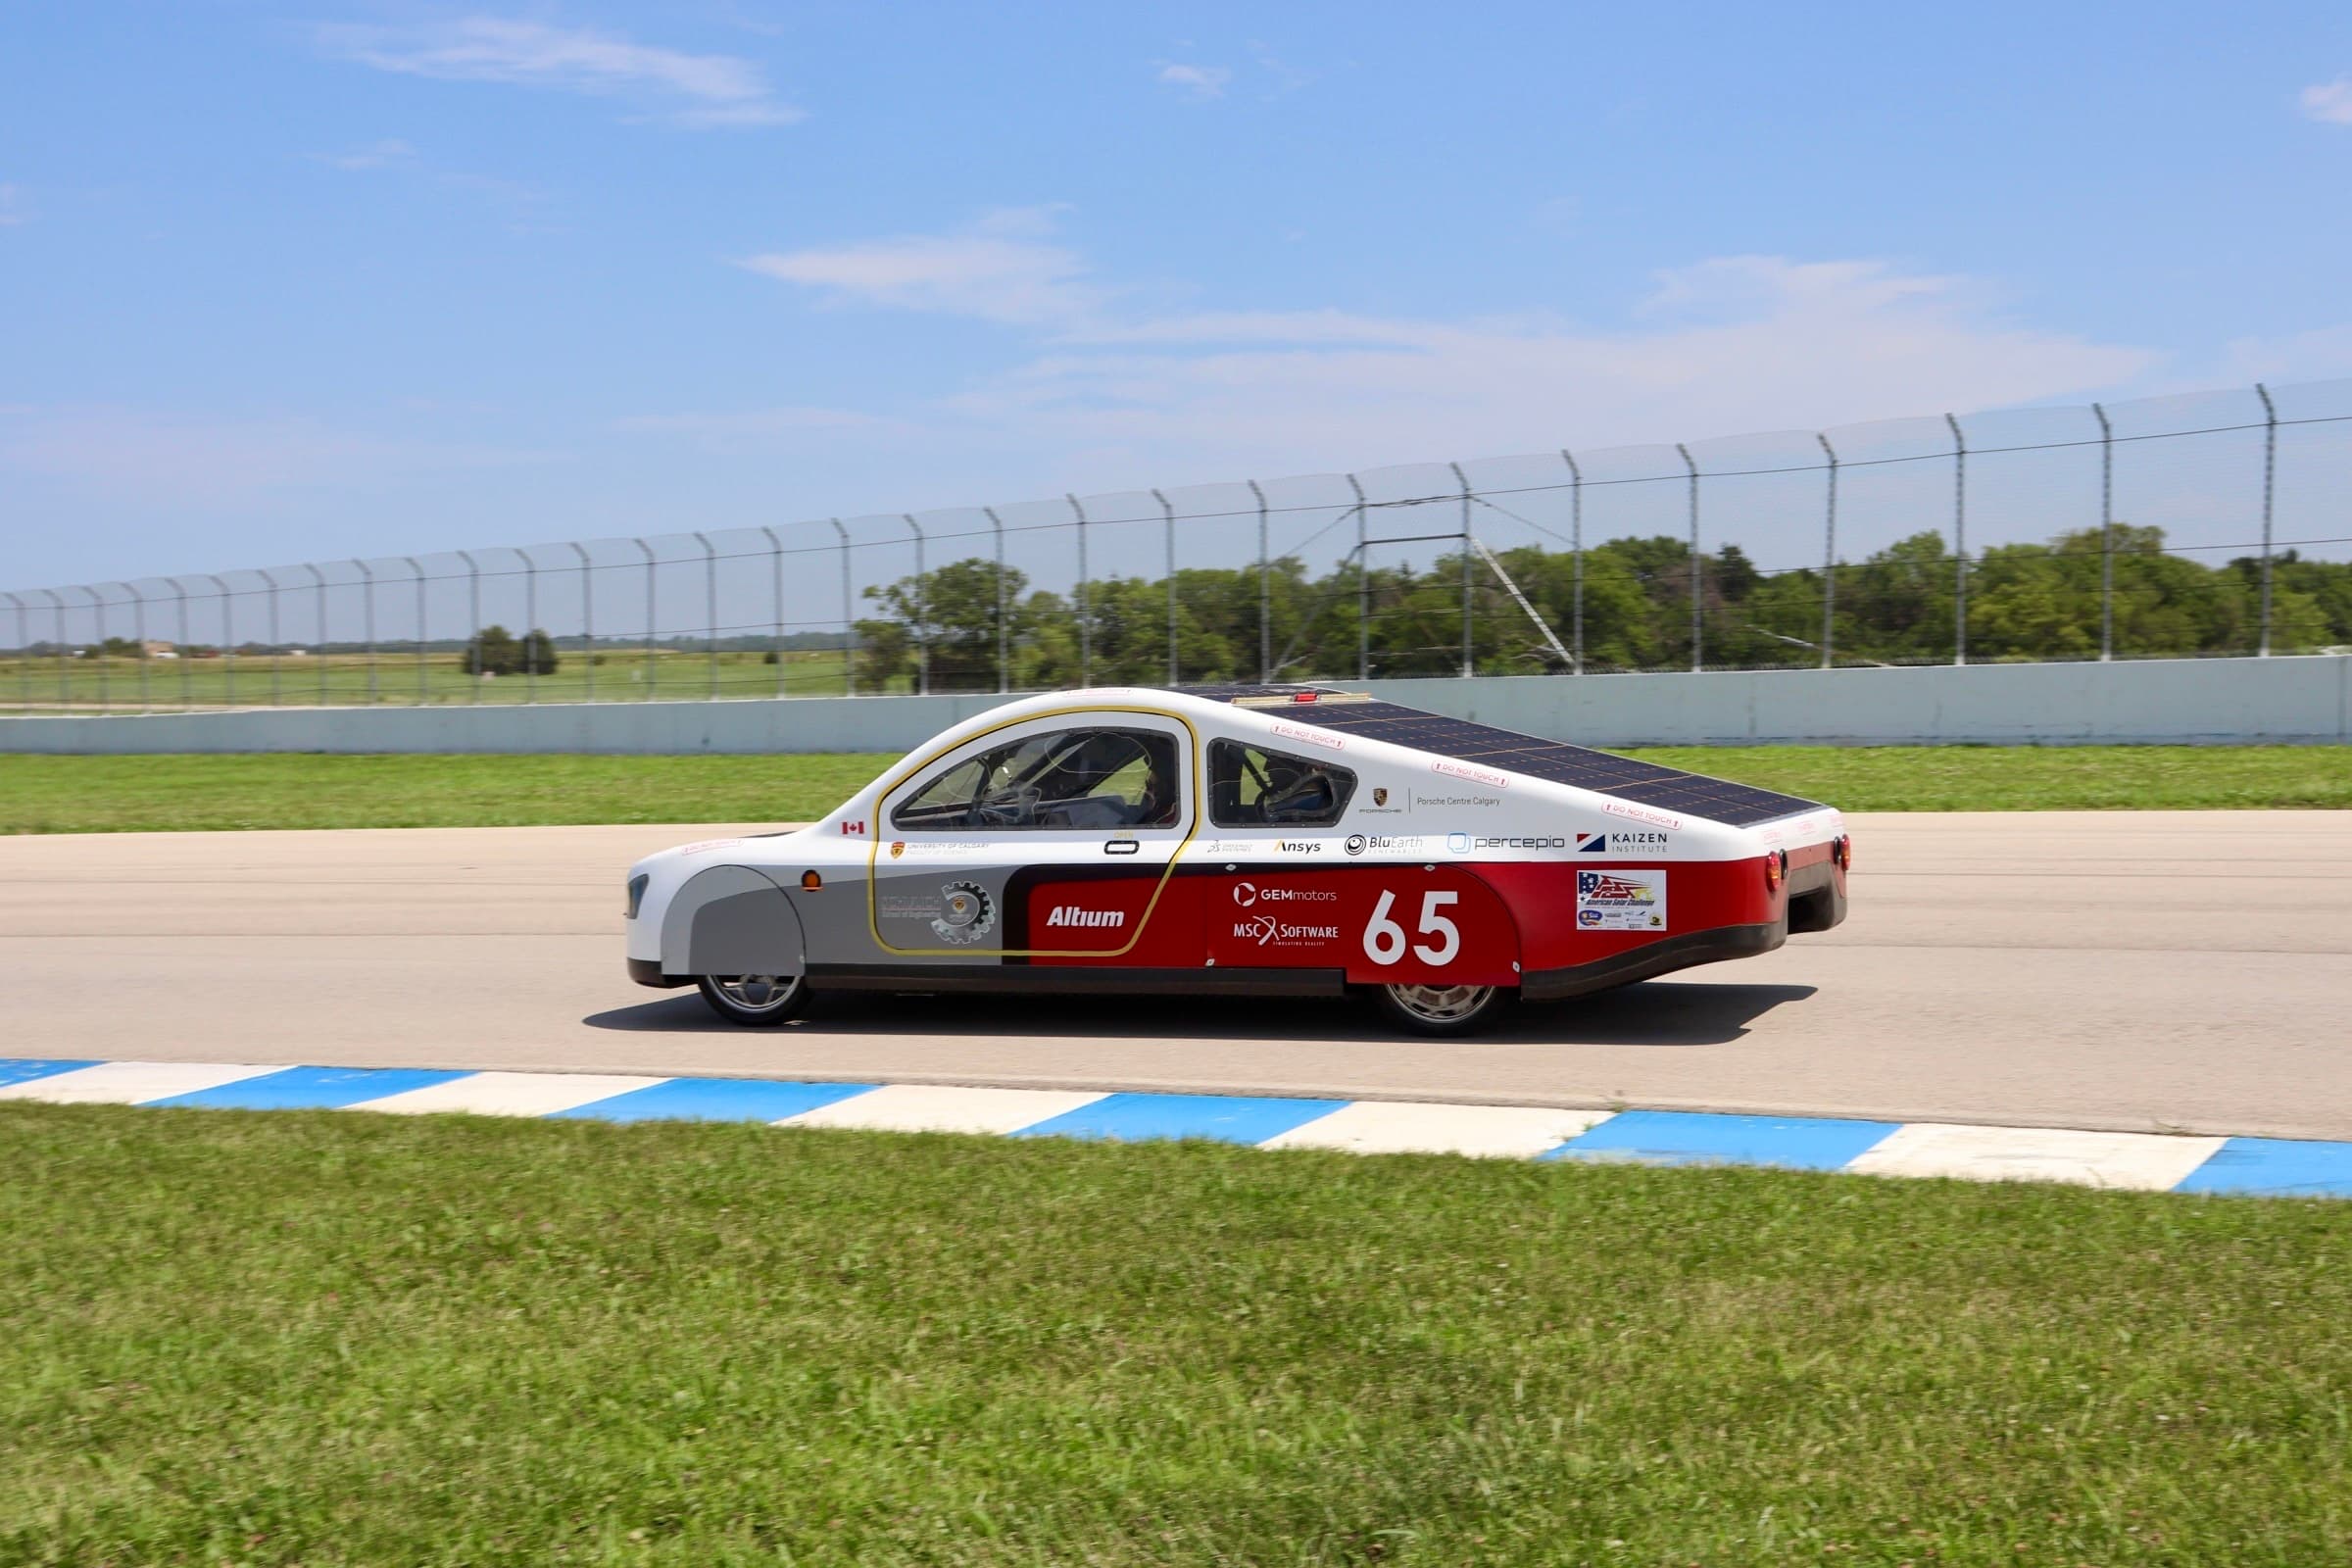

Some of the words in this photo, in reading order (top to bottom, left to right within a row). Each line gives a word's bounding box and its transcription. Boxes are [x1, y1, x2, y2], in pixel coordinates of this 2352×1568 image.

[1417, 796, 1446, 806] Porsche
[1446, 796, 1471, 806] Centre
[1472, 796, 1500, 808] Calgary
[1369, 835, 1423, 848] BluEarth
[1474, 835, 1565, 851] percepio
[1611, 833, 1668, 843] KAIZEN
[1273, 839, 1321, 855] Ansys
[1260, 889, 1337, 901] GEMmotors
[1046, 906, 1125, 927] Altium
[1362, 889, 1460, 966] 65
